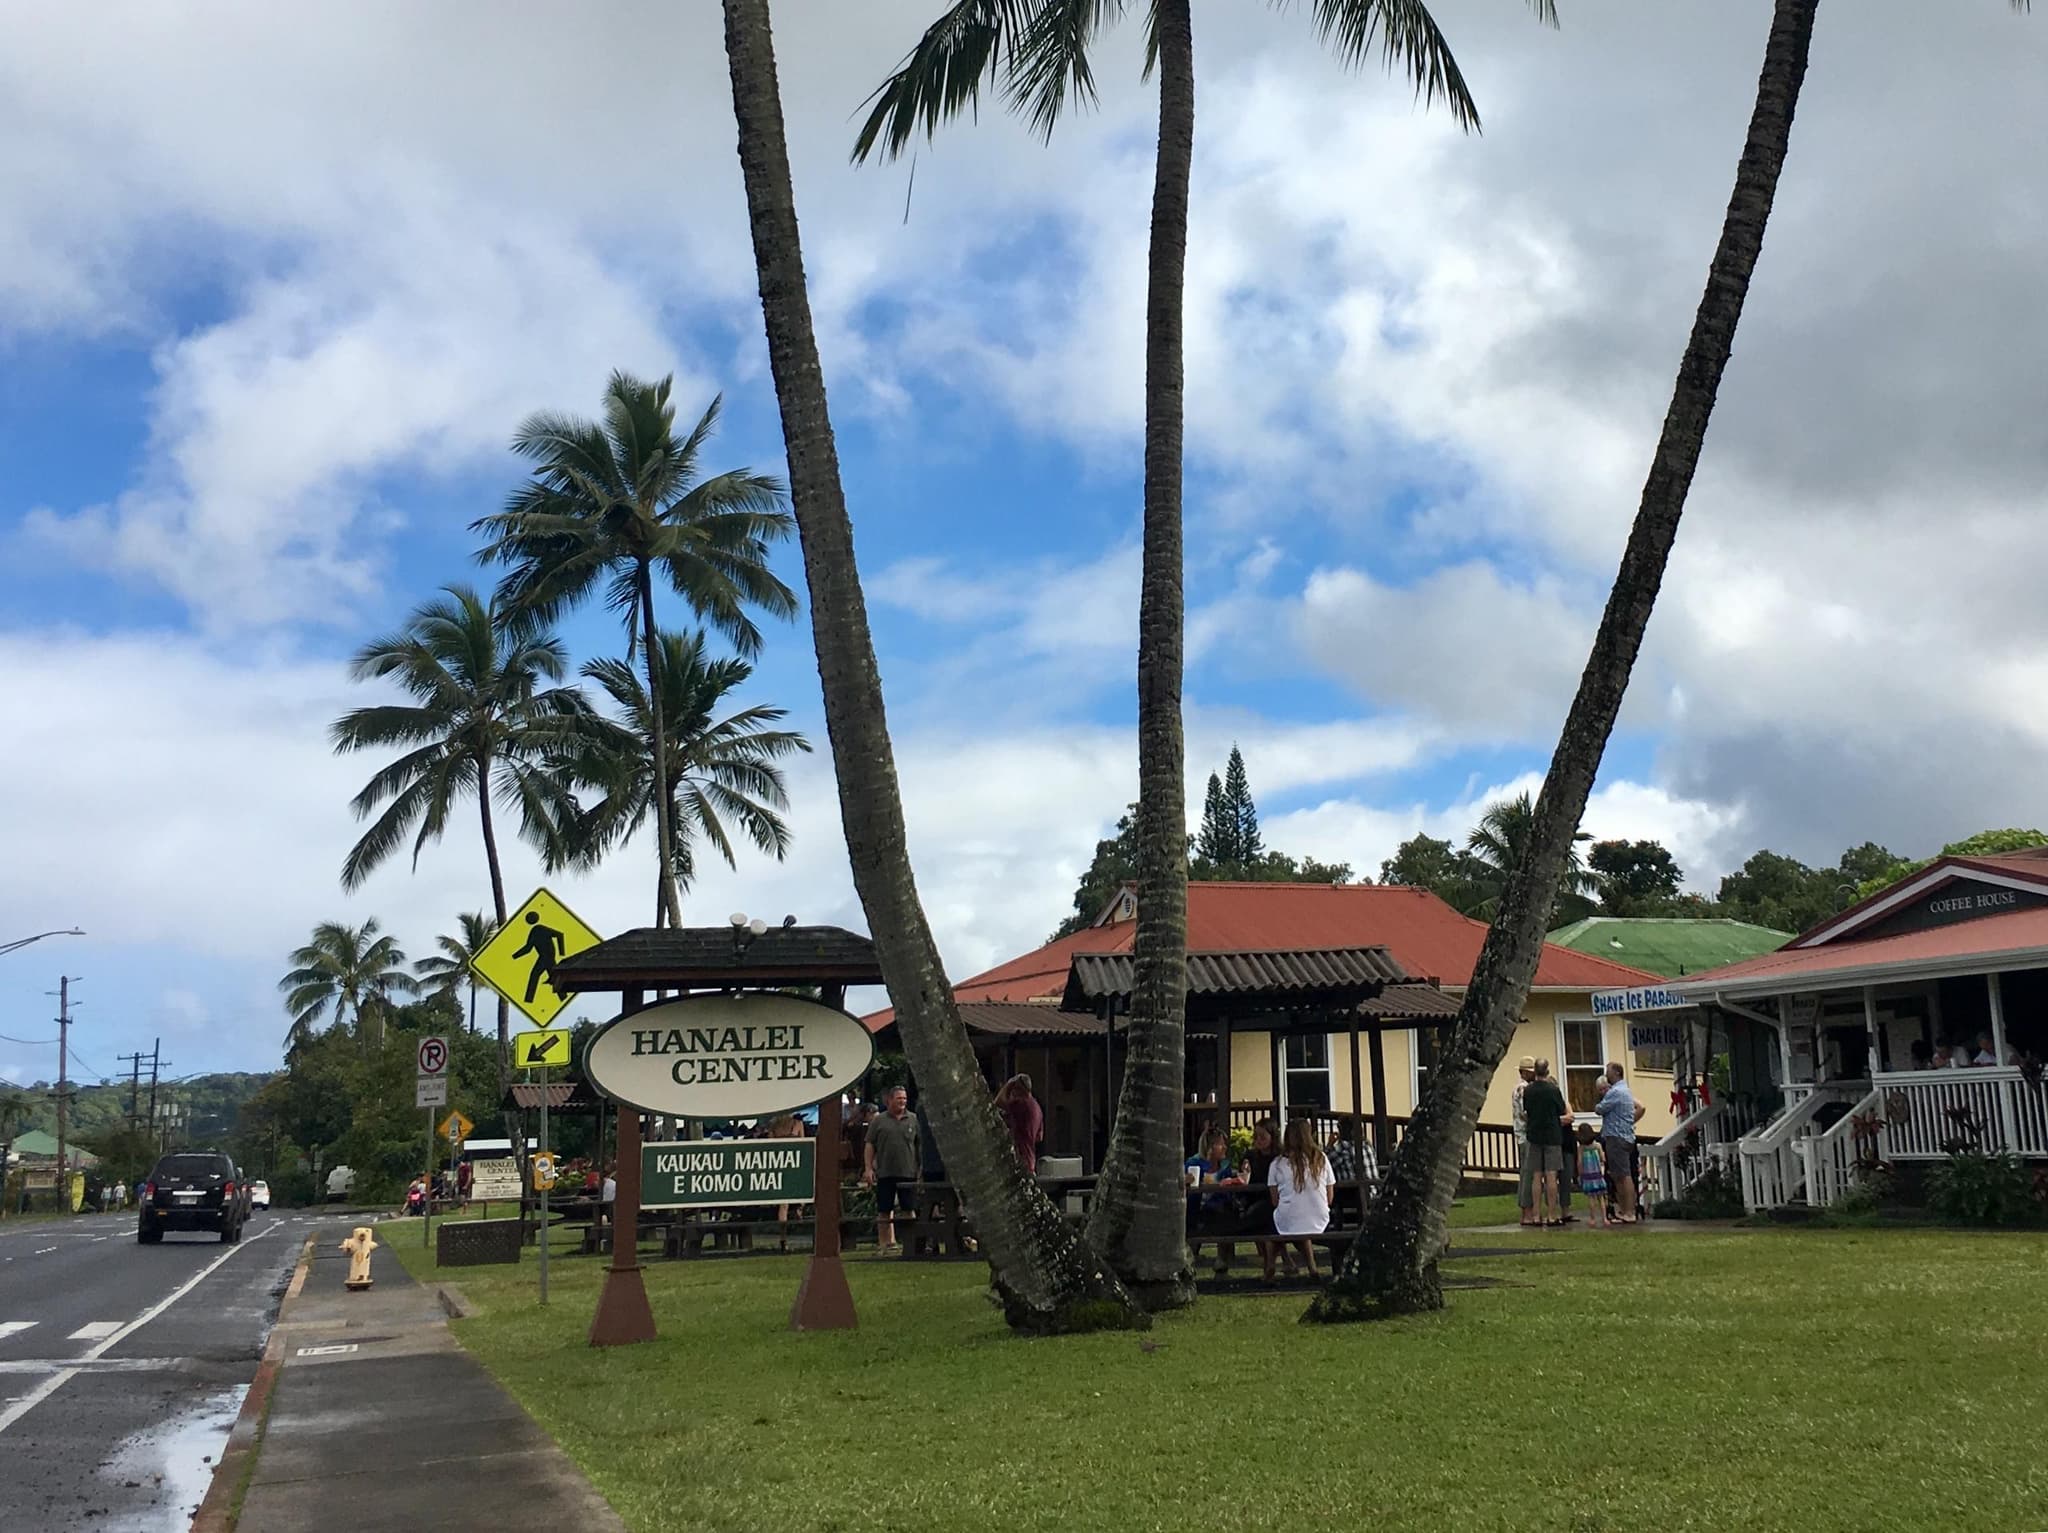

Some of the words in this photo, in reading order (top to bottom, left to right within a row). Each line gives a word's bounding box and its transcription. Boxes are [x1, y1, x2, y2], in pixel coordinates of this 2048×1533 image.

[1930, 897, 1973, 913] COFFEE
[1976, 891, 2016, 908] HOUSE
[1593, 994, 1625, 1014] SHAVE
[1626, 991, 1642, 1010] ICE
[631, 1025, 804, 1055] HANALEI
[1632, 1027, 1662, 1047] SHAVE
[1663, 1025, 1680, 1045] ICE
[671, 1054, 833, 1085] CENTER
[656, 1153, 724, 1173] KAUKAU
[735, 1150, 800, 1170] MAIMAI
[674, 1175, 685, 1194] E
[691, 1173, 743, 1193] KOMO
[750, 1172, 782, 1191] MAI
